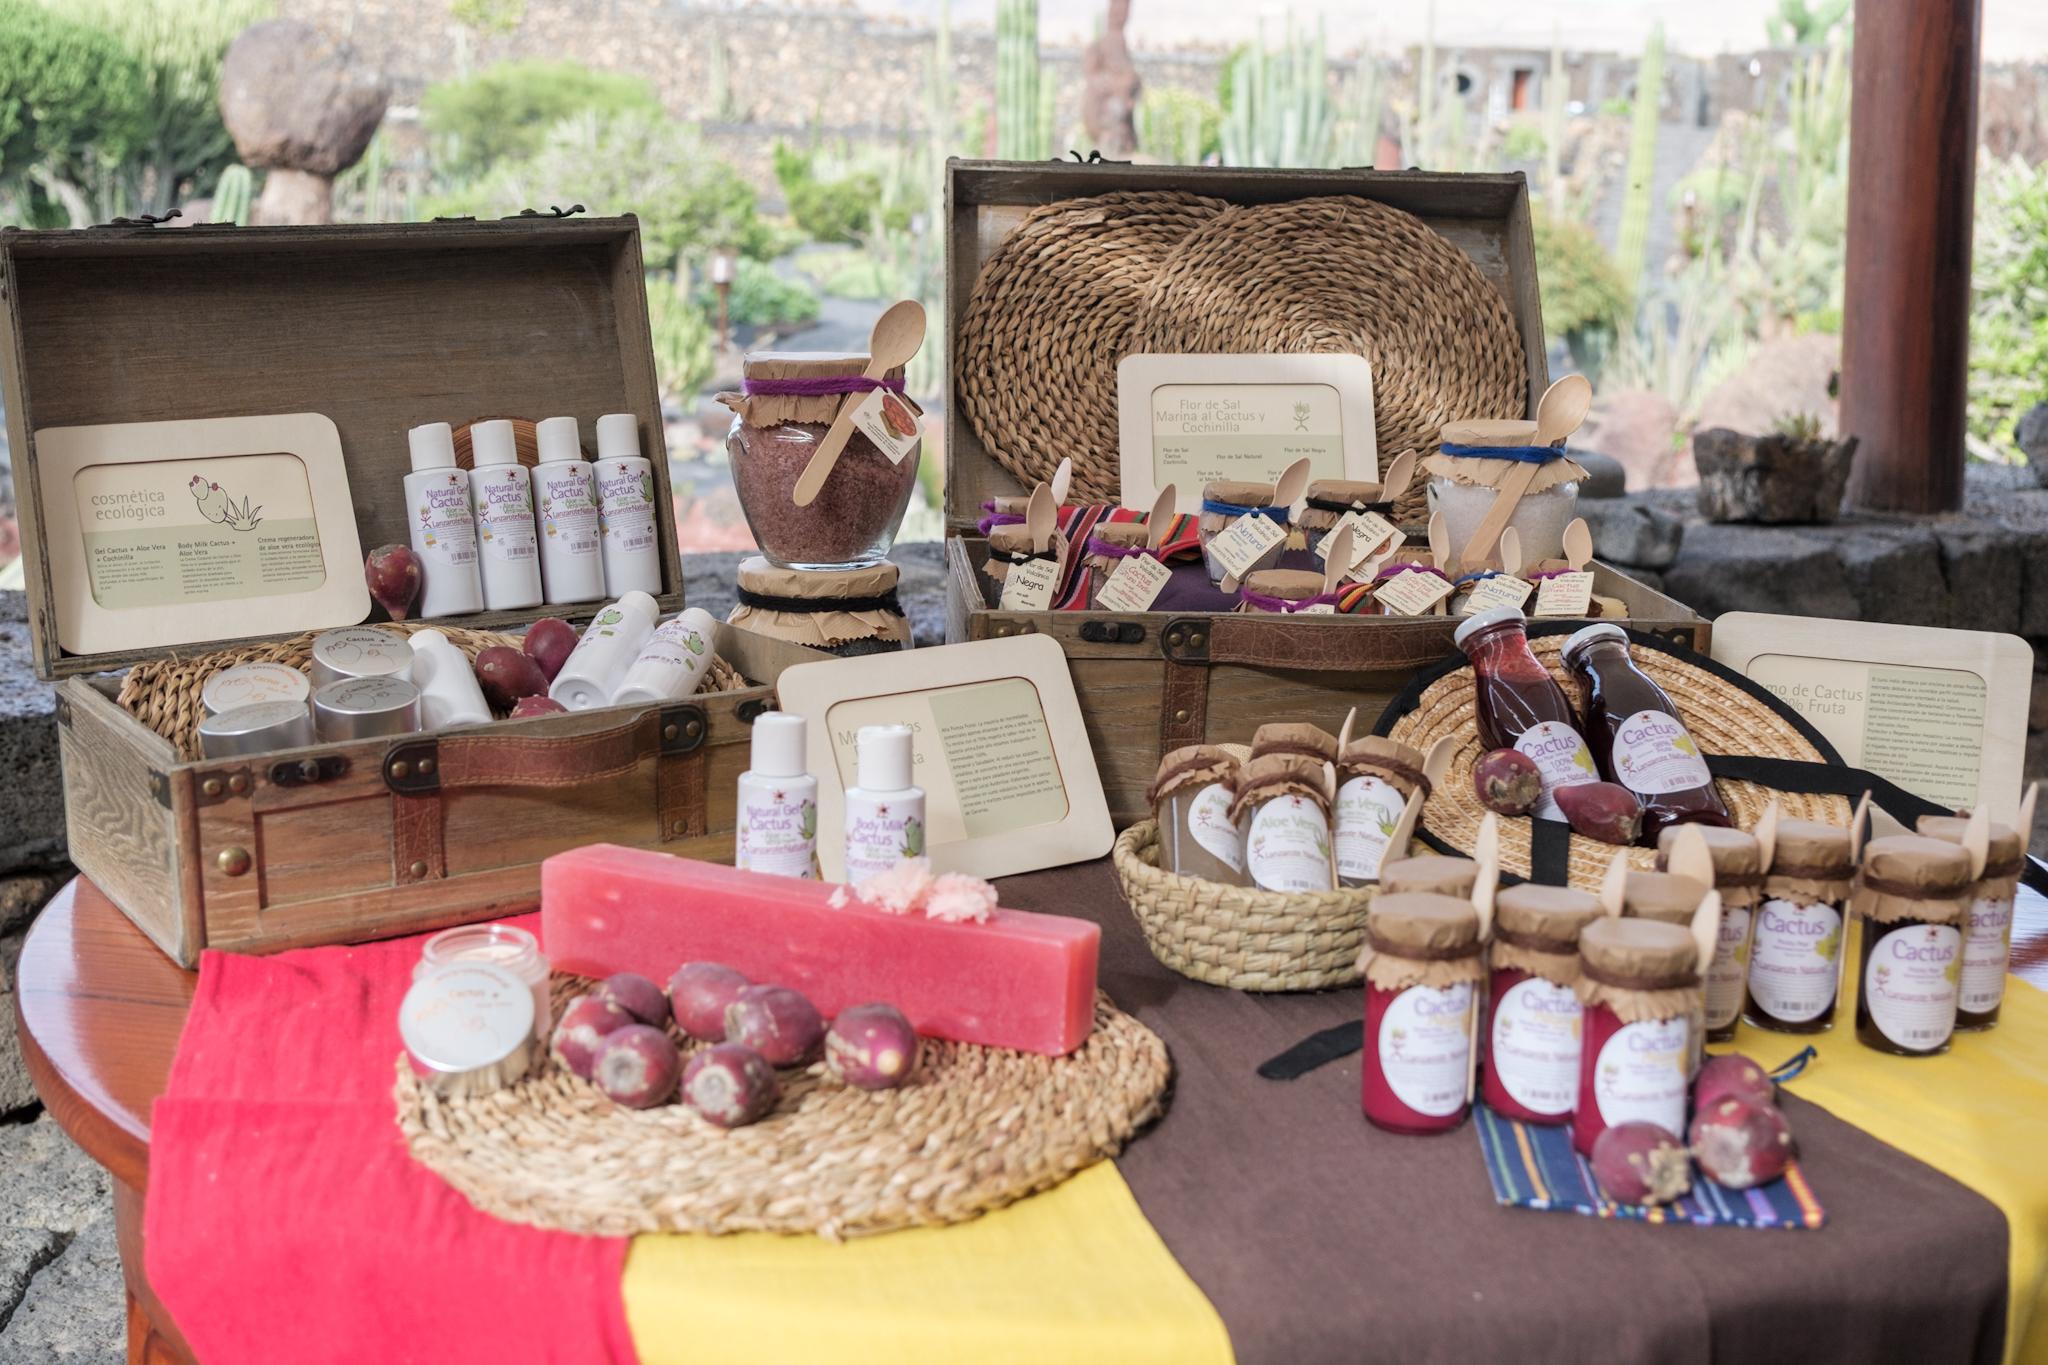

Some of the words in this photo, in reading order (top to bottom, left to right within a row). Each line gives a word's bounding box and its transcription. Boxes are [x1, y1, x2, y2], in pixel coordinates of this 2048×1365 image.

[1179, 399, 1202, 410] Flor
[1206, 399, 1219, 410] de
[1223, 399, 1240, 410] Sal
[1156, 411, 1198, 422] Marina
[1201, 411, 1213, 422] al
[1216, 411, 1256, 422] Cactus
[1258, 413, 1265, 423] y
[1182, 422, 1240, 434] Cochinilla
[485, 483, 514, 495] Natural
[547, 478, 576, 490] Natural
[600, 476, 625, 489] Natural
[627, 474, 640, 484] Gel
[91, 489, 165, 507] cosmética
[427, 487, 456, 499] Natural
[489, 493, 522, 504] Cactus
[551, 487, 584, 500] Cactus
[603, 485, 636, 499] Cactus
[430, 496, 464, 509] Cactus
[95, 503, 165, 521] ecológica
[1238, 523, 1266, 551] Natural
[1351, 522, 1372, 543] Negra
[107, 547, 128, 555] Cactus
[1015, 575, 1044, 591] Negra
[1129, 566, 1152, 586] Cactus
[1483, 584, 1522, 601] Natural
[1792, 683, 1809, 697] de
[1814, 684, 1864, 701] Cactus
[1808, 698, 1846, 715] Fruta
[1623, 723, 1678, 745] Cactus
[1522, 736, 1577, 760] Cactus
[747, 804, 781, 818] Natural
[783, 802, 800, 816] Gel
[1357, 796, 1386, 812] Vera
[749, 816, 792, 831] Cactus
[856, 817, 879, 833] Body
[882, 820, 904, 831] Milk
[1261, 816, 1289, 830] Aloe
[852, 827, 893, 846] Cactus
[1763, 911, 1825, 935] Cactus
[1968, 910, 2009, 928] actus
[1892, 938, 1954, 962] Cactus
[1414, 996, 1469, 1017] Cactus
[1522, 990, 1581, 1013] Cactus
